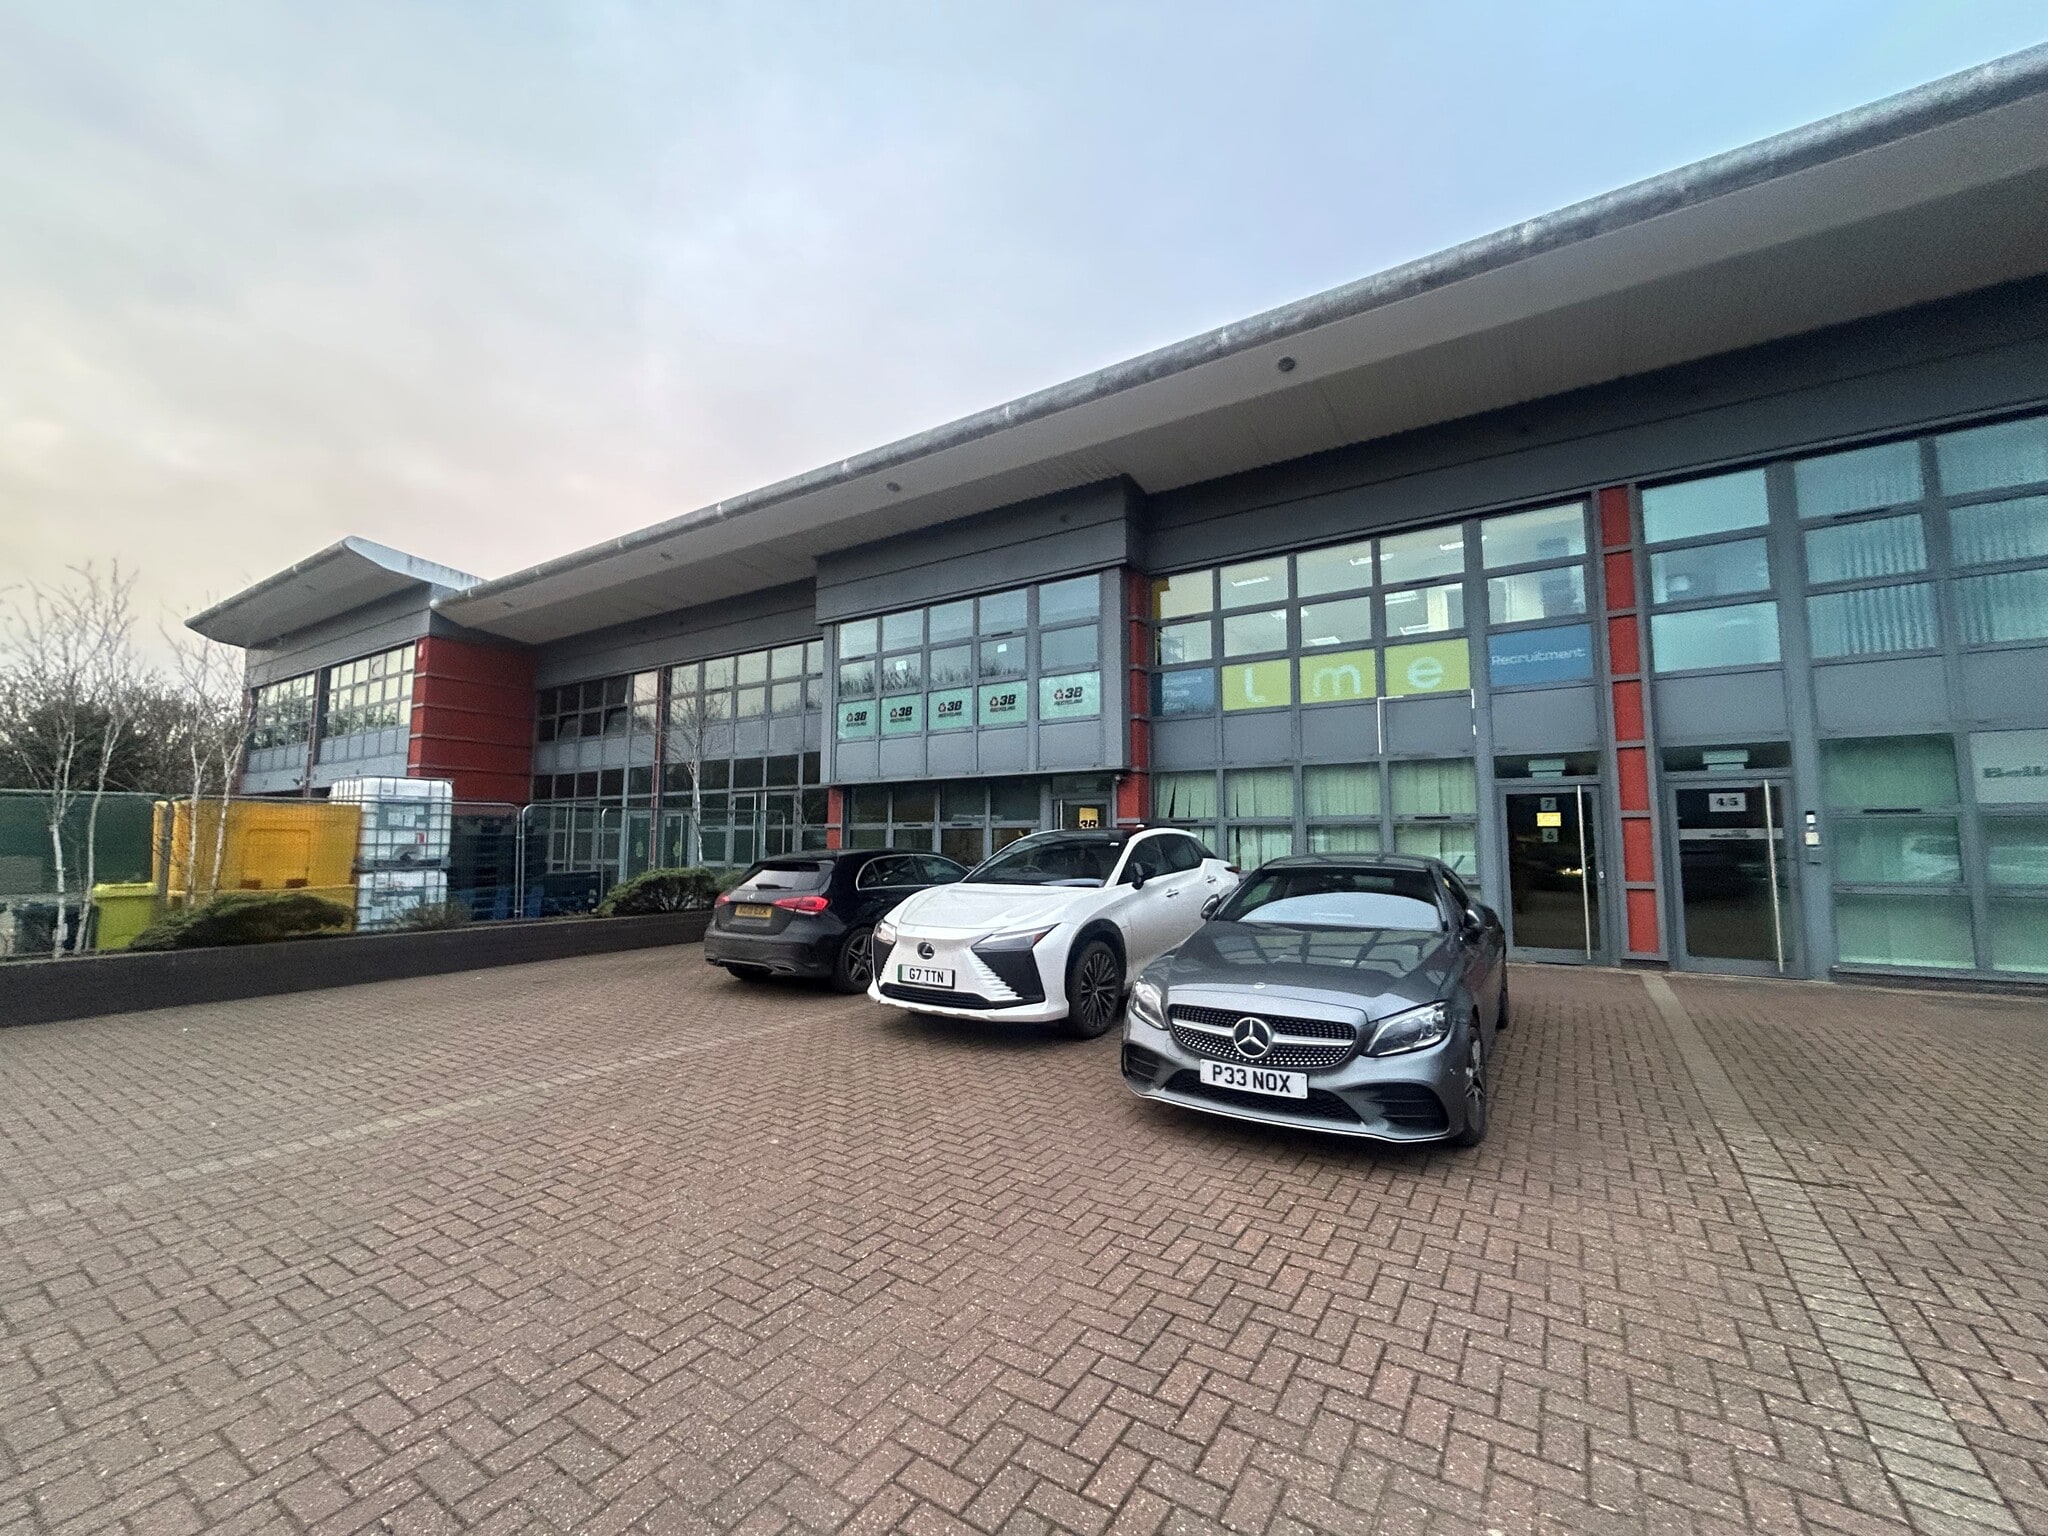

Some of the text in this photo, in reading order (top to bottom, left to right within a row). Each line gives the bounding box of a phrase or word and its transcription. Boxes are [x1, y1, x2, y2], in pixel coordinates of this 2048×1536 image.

[1491, 648, 1586, 666] Recruitment
[1065, 687, 1083, 698] 3B
[1000, 694, 1016, 705] 3B
[947, 700, 962, 711] 3B
[854, 711, 867, 721] 3B
[899, 706, 912, 717] 3B
[1546, 831, 1554, 840] 6
[909, 968, 943, 983] G7 TTN
[1212, 1064, 1291, 1093] P33 NOX
